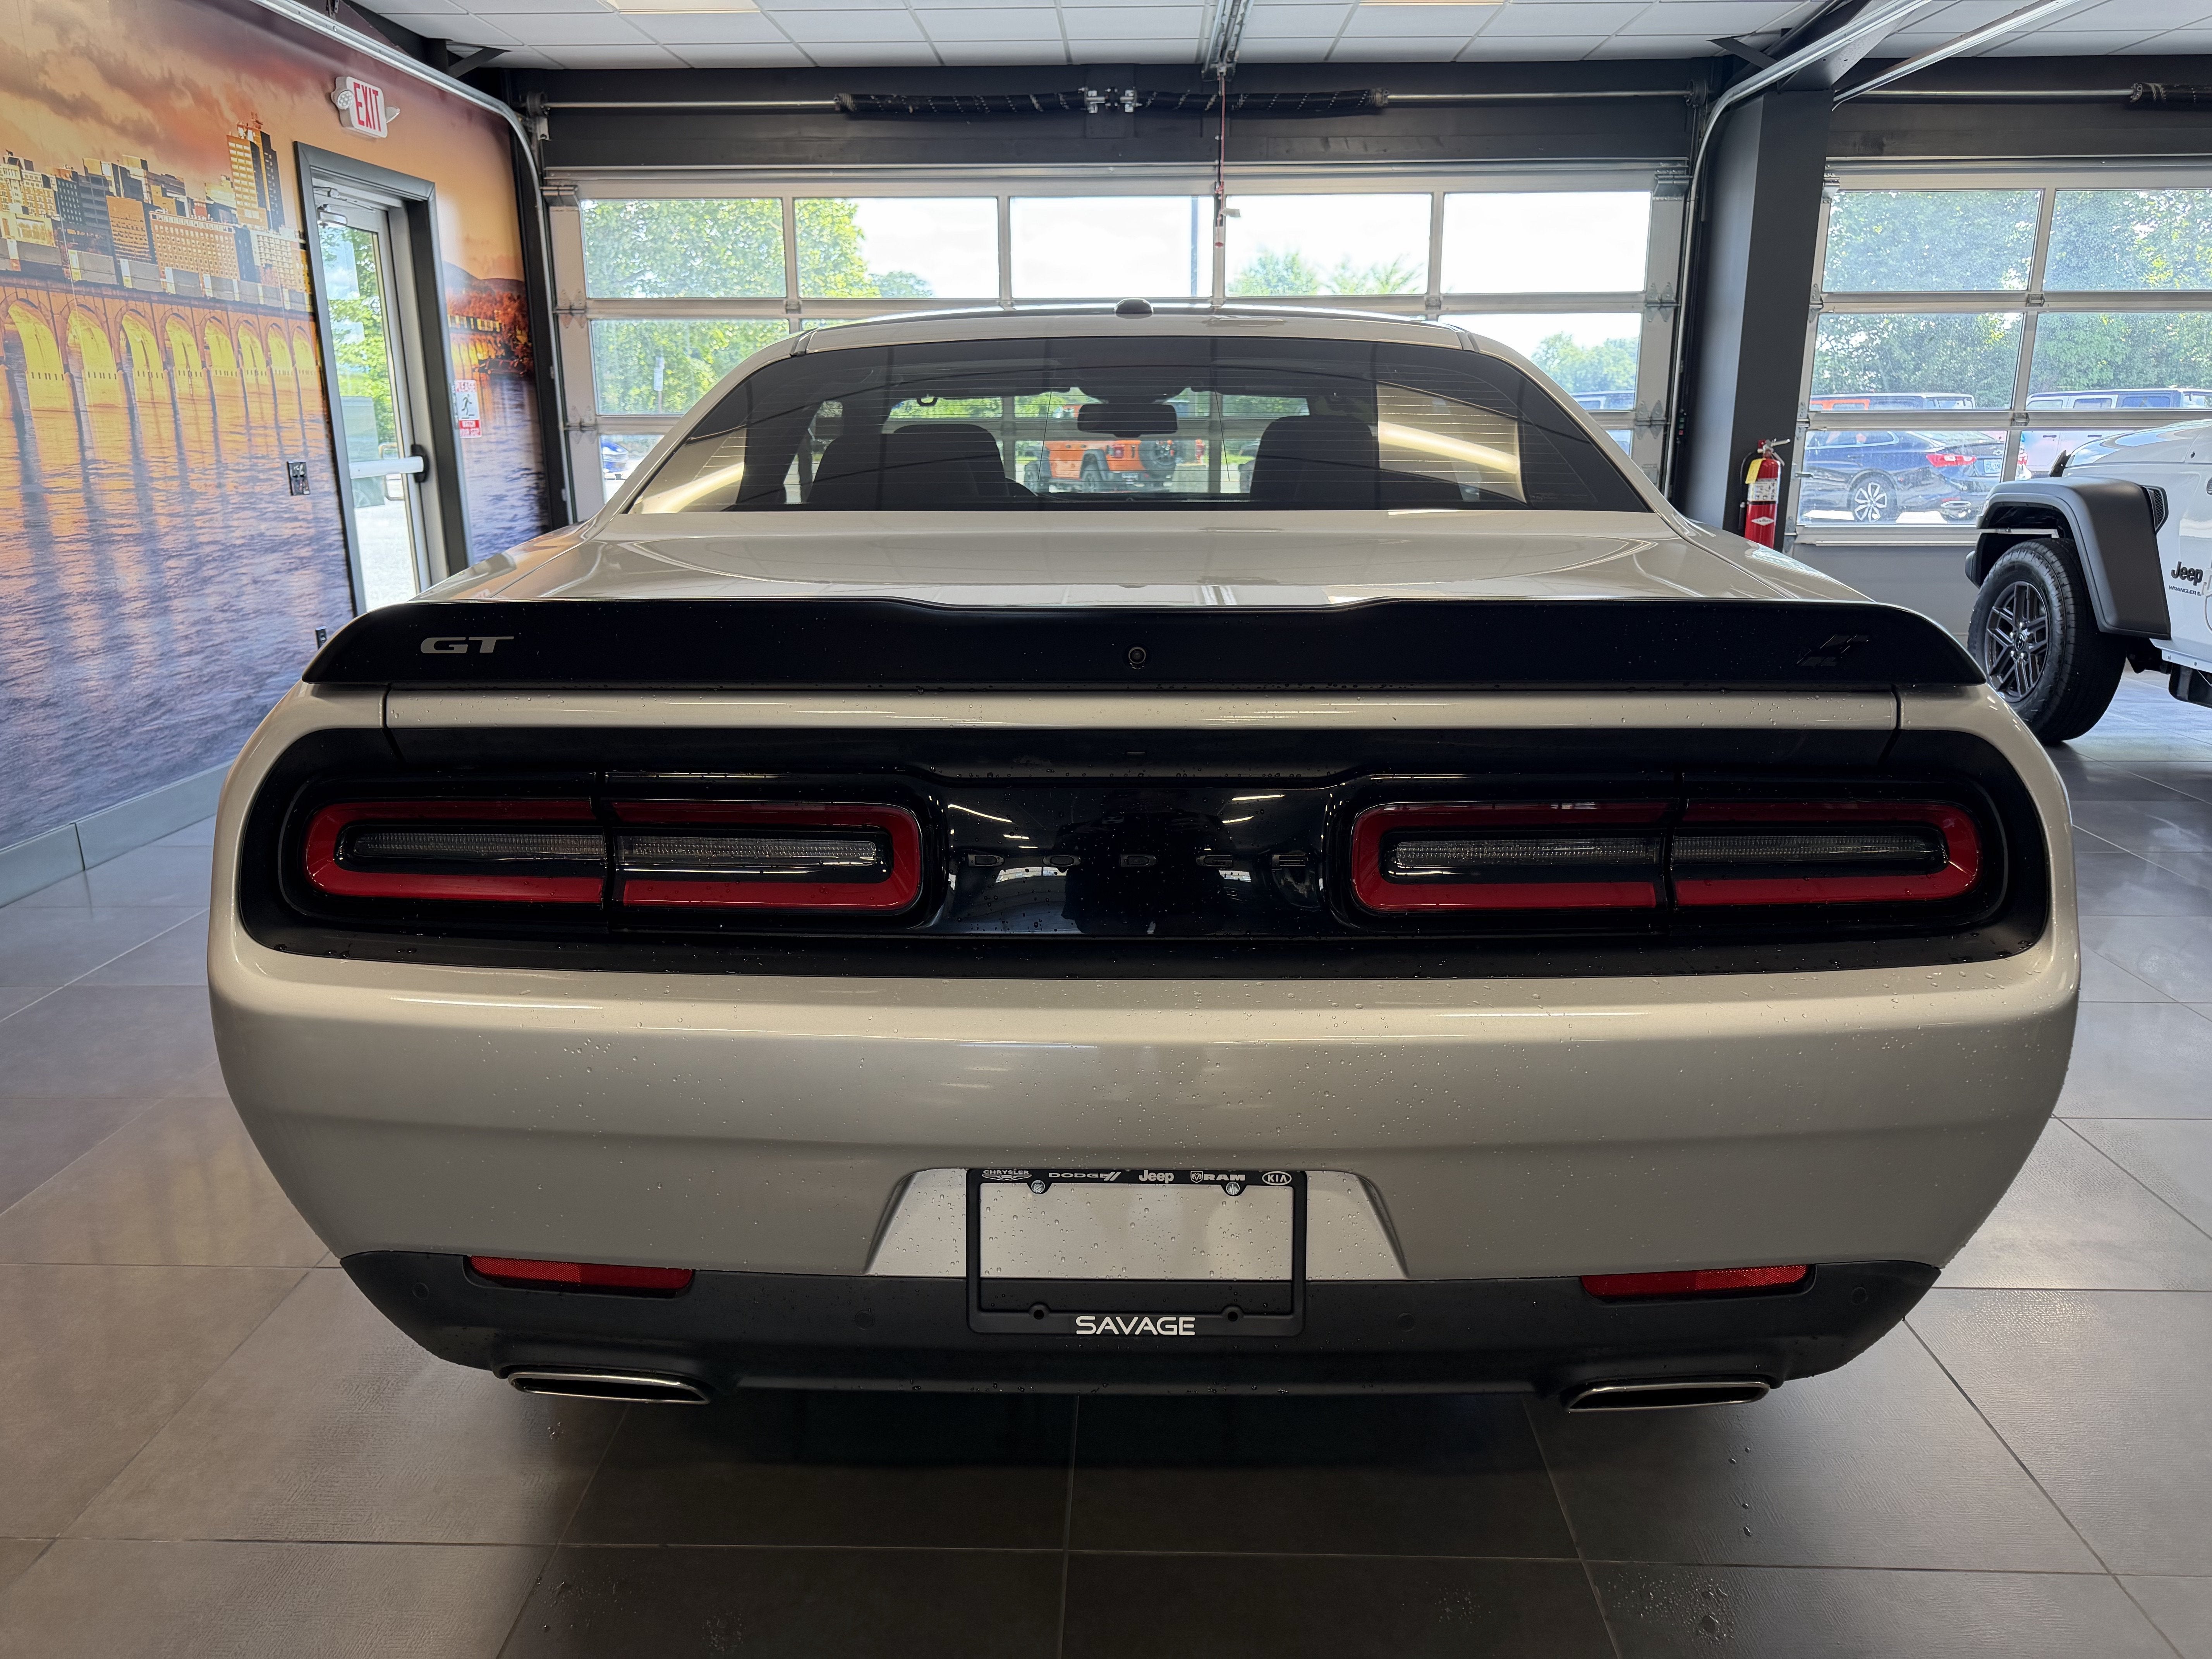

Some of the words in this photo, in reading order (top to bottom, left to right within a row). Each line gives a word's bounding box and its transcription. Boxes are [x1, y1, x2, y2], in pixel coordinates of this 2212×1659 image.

[354, 82, 381, 132] EXIT
[2171, 561, 2203, 586] Jeep
[2169, 585, 2196, 595] WRANGLER
[421, 636, 514, 653] GT
[968, 854, 1309, 867] DODGE
[1139, 1170, 1174, 1183] Jeep
[1076, 1316, 1195, 1336] SAVAGE
